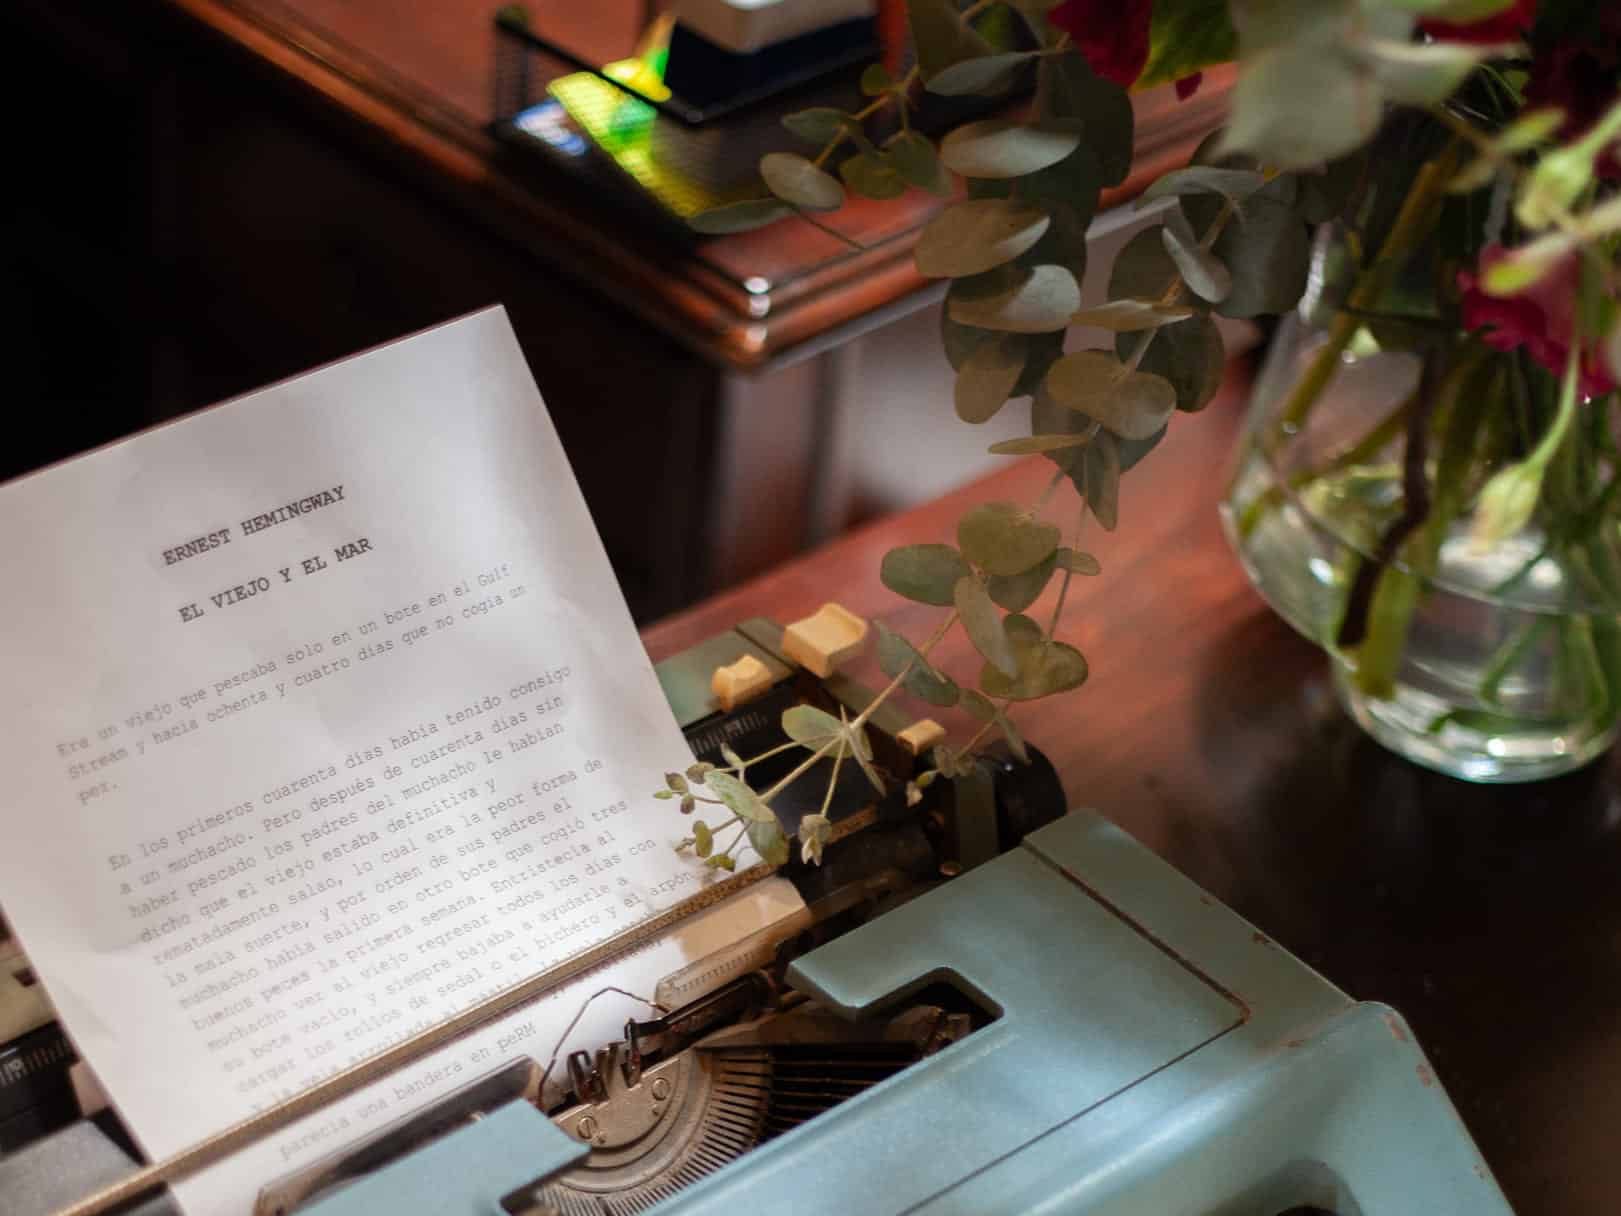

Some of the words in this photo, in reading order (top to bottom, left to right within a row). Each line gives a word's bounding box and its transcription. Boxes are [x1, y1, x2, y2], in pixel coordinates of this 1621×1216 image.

[162, 527, 233, 565] ERNEST
[241, 484, 347, 535] HEMINGWAY
[179, 602, 205, 623] EL
[211, 576, 271, 610] VIEJO
[279, 567, 293, 583] Y
[302, 554, 327, 574] EL
[334, 536, 373, 562] MAR
[178, 688, 209, 711] que
[213, 660, 277, 697] pescaba
[285, 641, 323, 664] solo
[331, 630, 351, 645] en
[358, 619, 378, 634] un
[383, 601, 422, 624] bote
[428, 590, 447, 606] en
[453, 577, 471, 596] el
[207, 690, 268, 723] ochenta
[294, 655, 351, 687] cuatro
[401, 624, 429, 646] que
[434, 613, 455, 629] no
[106, 854, 132, 871] En
[140, 837, 170, 857] los
[177, 801, 255, 844] primeros
[262, 765, 337, 804] cuarenta
[445, 694, 502, 726] tenido
[509, 665, 570, 698] consigo
[128, 890, 179, 919] haber
[188, 855, 257, 896] pescado
[262, 839, 294, 859] los
[300, 810, 359, 846] padres
[363, 792, 394, 815] del
[400, 760, 475, 799] muchacho
[483, 748, 502, 763] le
[141, 870, 161, 886] un
[168, 833, 254, 874] muchacho.
[260, 808, 303, 833] Pero
[380, 764, 402, 780] de
[409, 729, 483, 768] cuarenta
[535, 694, 562, 713] sin
[287, 878, 344, 905] salao,
[351, 859, 375, 876] lo
[381, 837, 419, 863] cual
[425, 824, 455, 844] era
[461, 813, 480, 827] la
[488, 793, 524, 819] peor
[532, 770, 577, 796] forma
[583, 759, 602, 774] de
[138, 913, 192, 942] dicho
[198, 896, 231, 920] que
[237, 880, 259, 900] el
[265, 859, 315, 888] viejo
[322, 831, 379, 863] estaba
[384, 785, 479, 834] definitiva
[315, 957, 339, 973] la
[345, 923, 414, 964] primera
[422, 895, 485, 926] semana.
[597, 826, 615, 844] al
[324, 911, 381, 944] salido
[387, 898, 408, 914] en
[415, 878, 453, 902] otro
[460, 858, 498, 881] bote
[505, 842, 532, 864] que
[592, 800, 627, 822] tres
[337, 891, 367, 914] por
[374, 866, 422, 894] orden
[429, 854, 449, 869] de
[457, 837, 486, 857] sus
[492, 809, 545, 843] padres
[553, 795, 570, 813] el
[360, 950, 409, 980] viejo
[416, 913, 490, 954] regresar
[497, 888, 544, 916] todos
[546, 873, 577, 893] los
[630, 838, 655, 856] con
[385, 959, 450, 995] siempre
[455, 928, 515, 962] bajaba
[543, 884, 610, 922] ayudarle
[406, 994, 427, 1010] de
[436, 966, 480, 996] sedal
[509, 943, 527, 961] el
[534, 913, 600, 948] bichero
[624, 891, 640, 908] el
[470, 1047, 489, 1063] en
[496, 1020, 534, 1052] peRM
